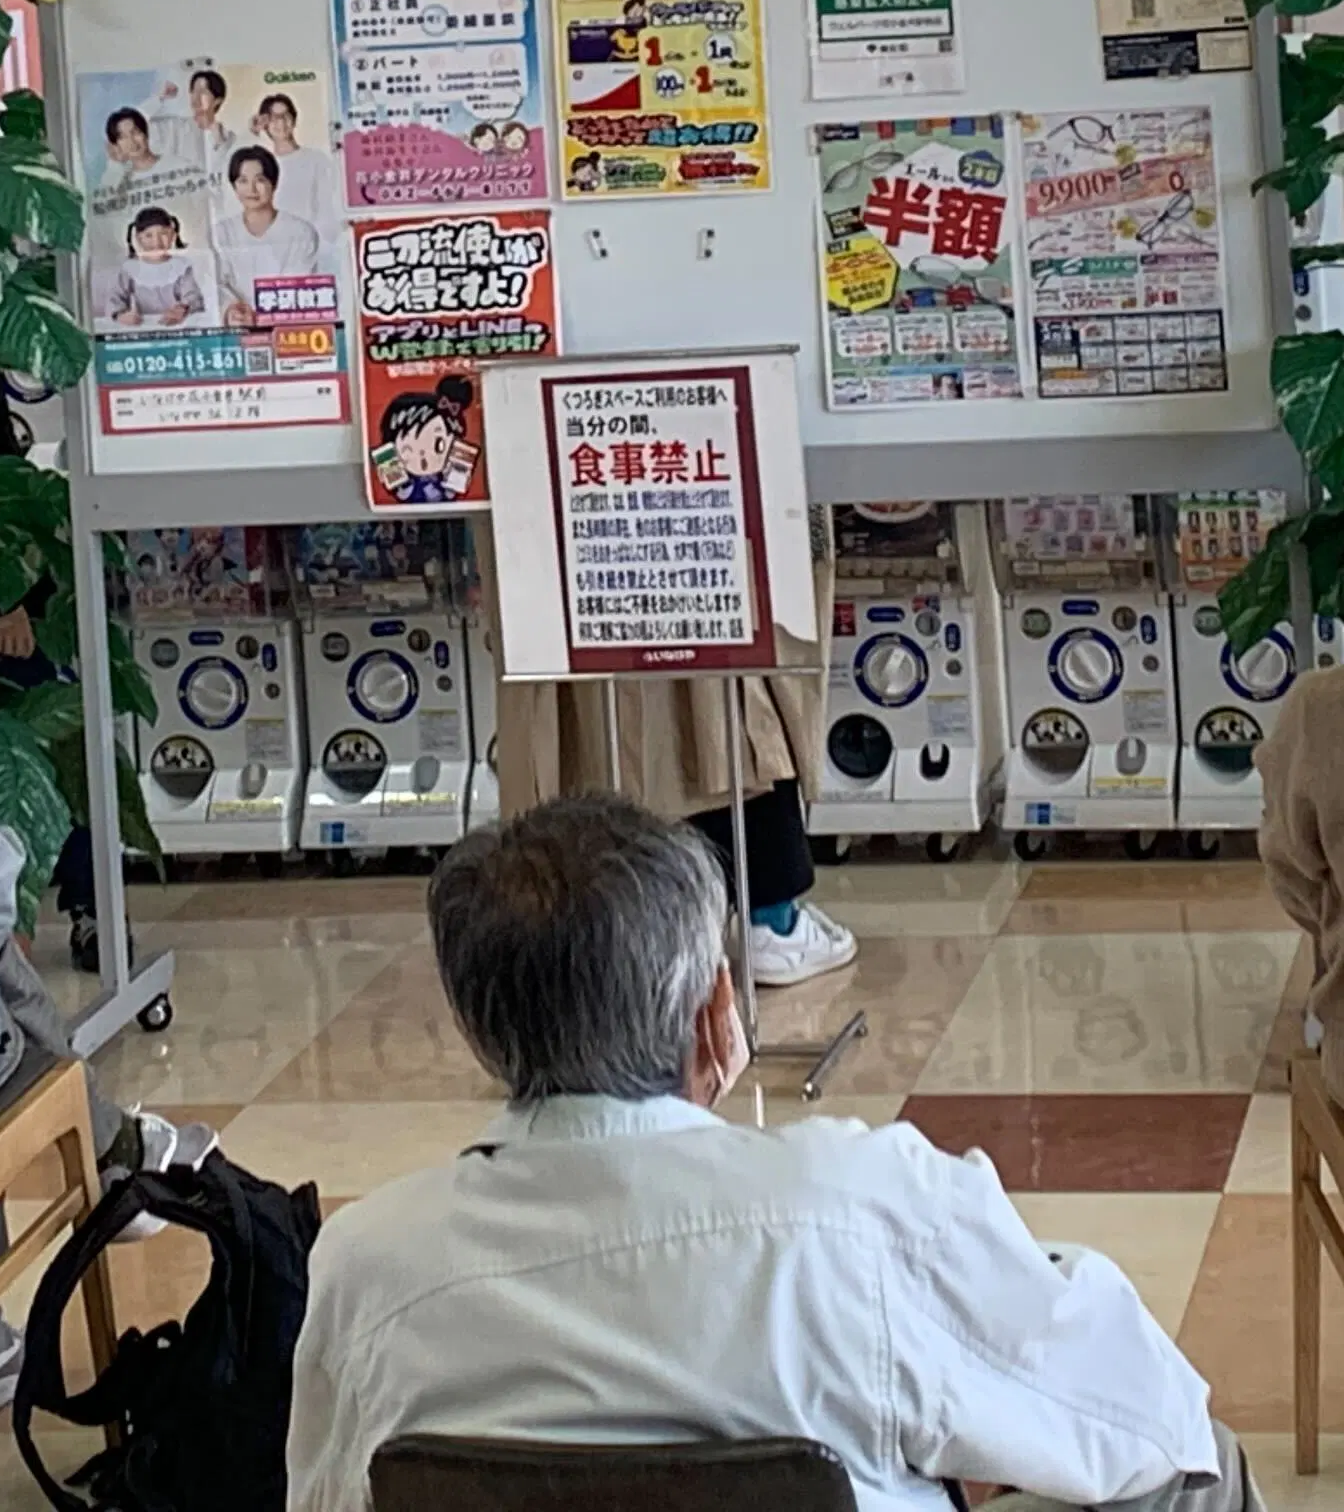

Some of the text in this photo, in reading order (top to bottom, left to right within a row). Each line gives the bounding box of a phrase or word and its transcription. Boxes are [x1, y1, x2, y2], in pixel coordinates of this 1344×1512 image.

[264, 71, 316, 84] Gakken
[863, 177, 1008, 264] 半額
[366, 223, 544, 269] 二刀流使いが
[365, 270, 528, 314] お得ですよ!
[562, 384, 727, 409] くつろぎスペースご利用のお客様へ
[566, 414, 658, 437] 当分の間、
[569, 439, 731, 487] 食事禁止
